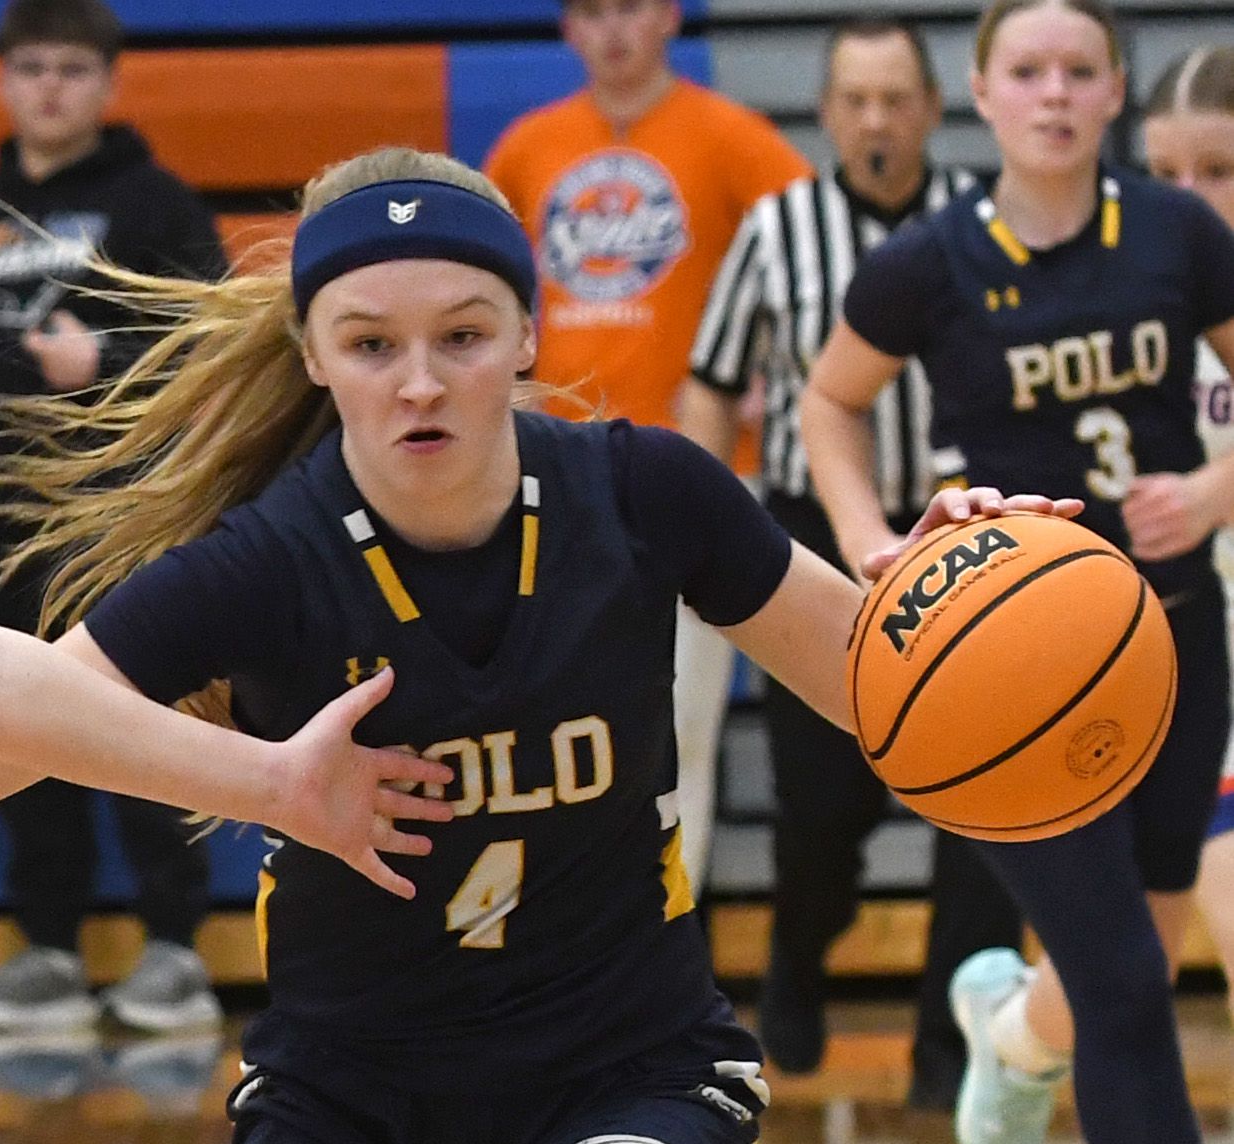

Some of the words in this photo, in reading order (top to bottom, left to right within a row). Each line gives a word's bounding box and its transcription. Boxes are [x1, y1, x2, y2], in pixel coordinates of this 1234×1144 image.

[1005, 319, 1168, 411] POLO
[1074, 407, 1136, 500] 3
[880, 527, 1020, 655] NCAA
[948, 570, 987, 603] GAME
[988, 551, 1028, 571] BALL
[378, 714, 615, 818] OLO
[444, 838, 525, 949] 4
